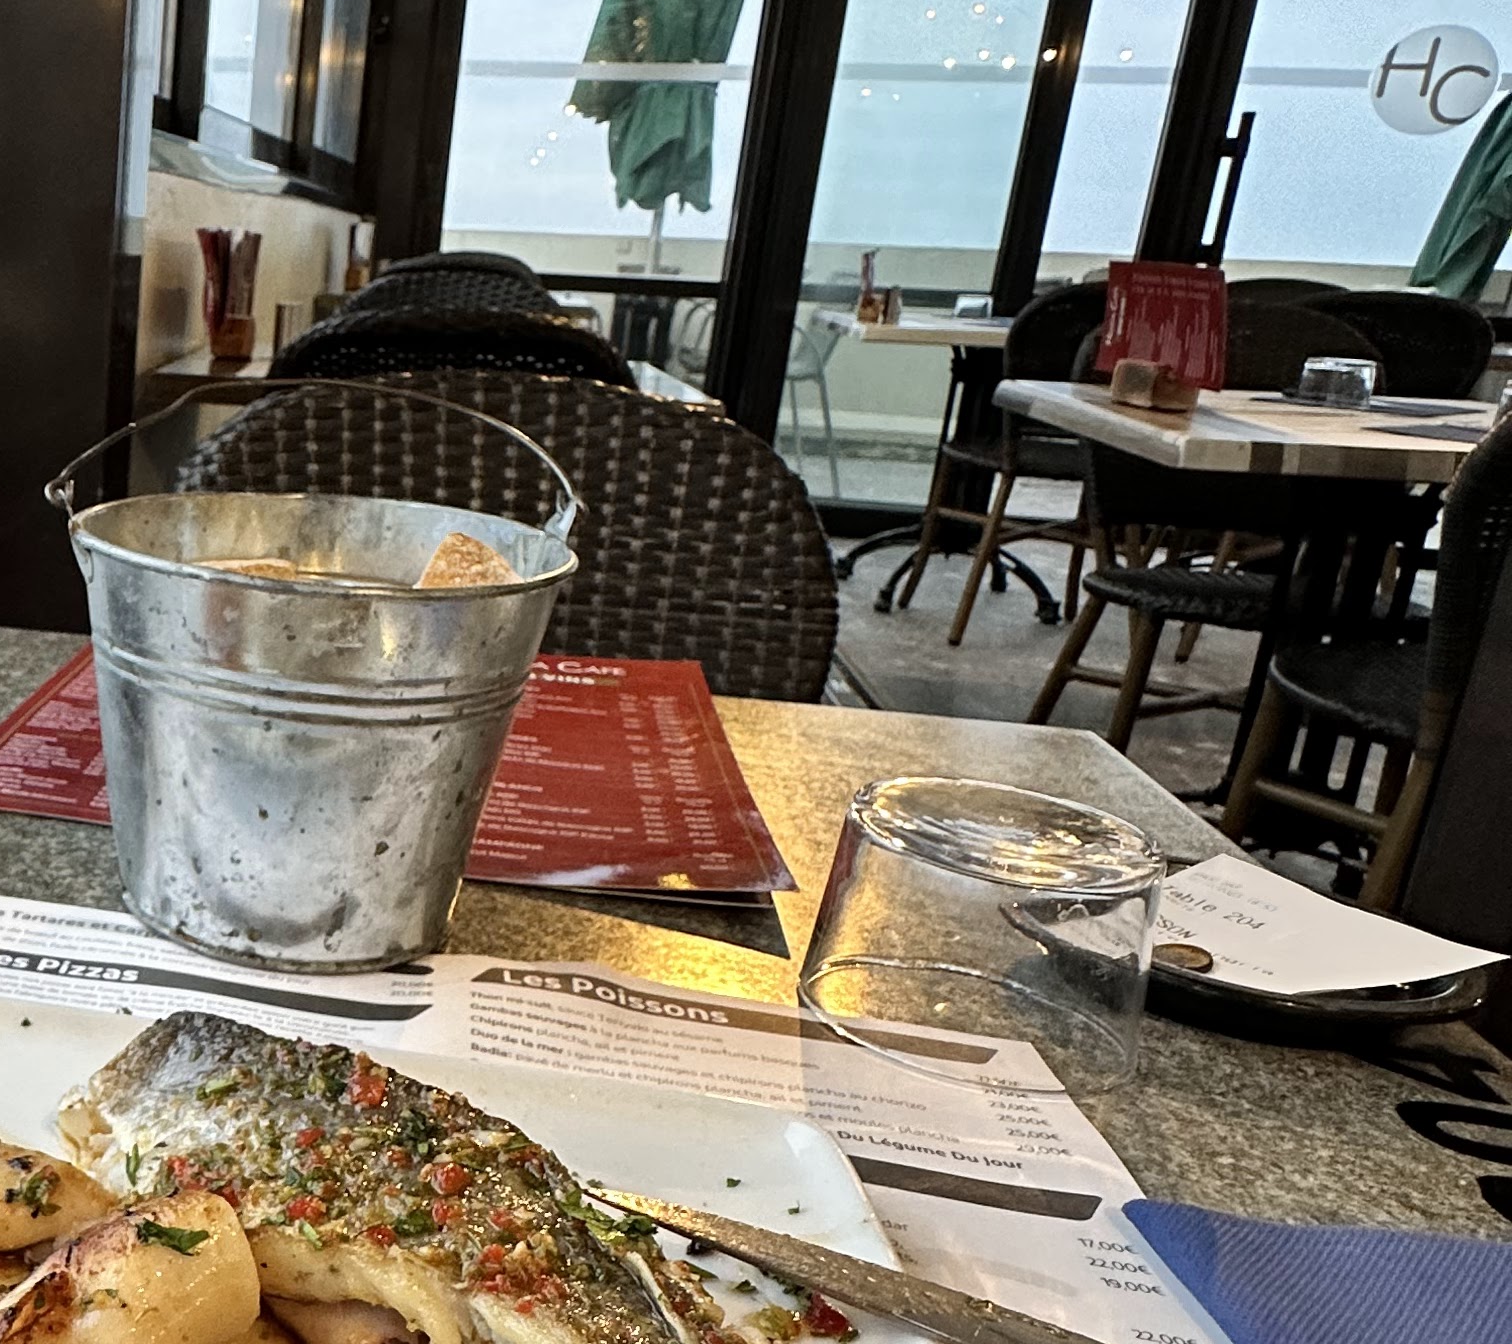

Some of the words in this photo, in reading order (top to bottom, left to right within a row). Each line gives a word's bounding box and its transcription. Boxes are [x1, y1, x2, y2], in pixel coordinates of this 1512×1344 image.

[1223, 911, 1265, 929] 204
[36, 959, 140, 982] Pizzas
[502, 969, 563, 989] Les
[571, 976, 729, 1025] Poissons
[868, 1135, 947, 1158] Légume
[951, 1151, 979, 1164] Du
[1086, 1256, 1153, 1276] 22,00€
